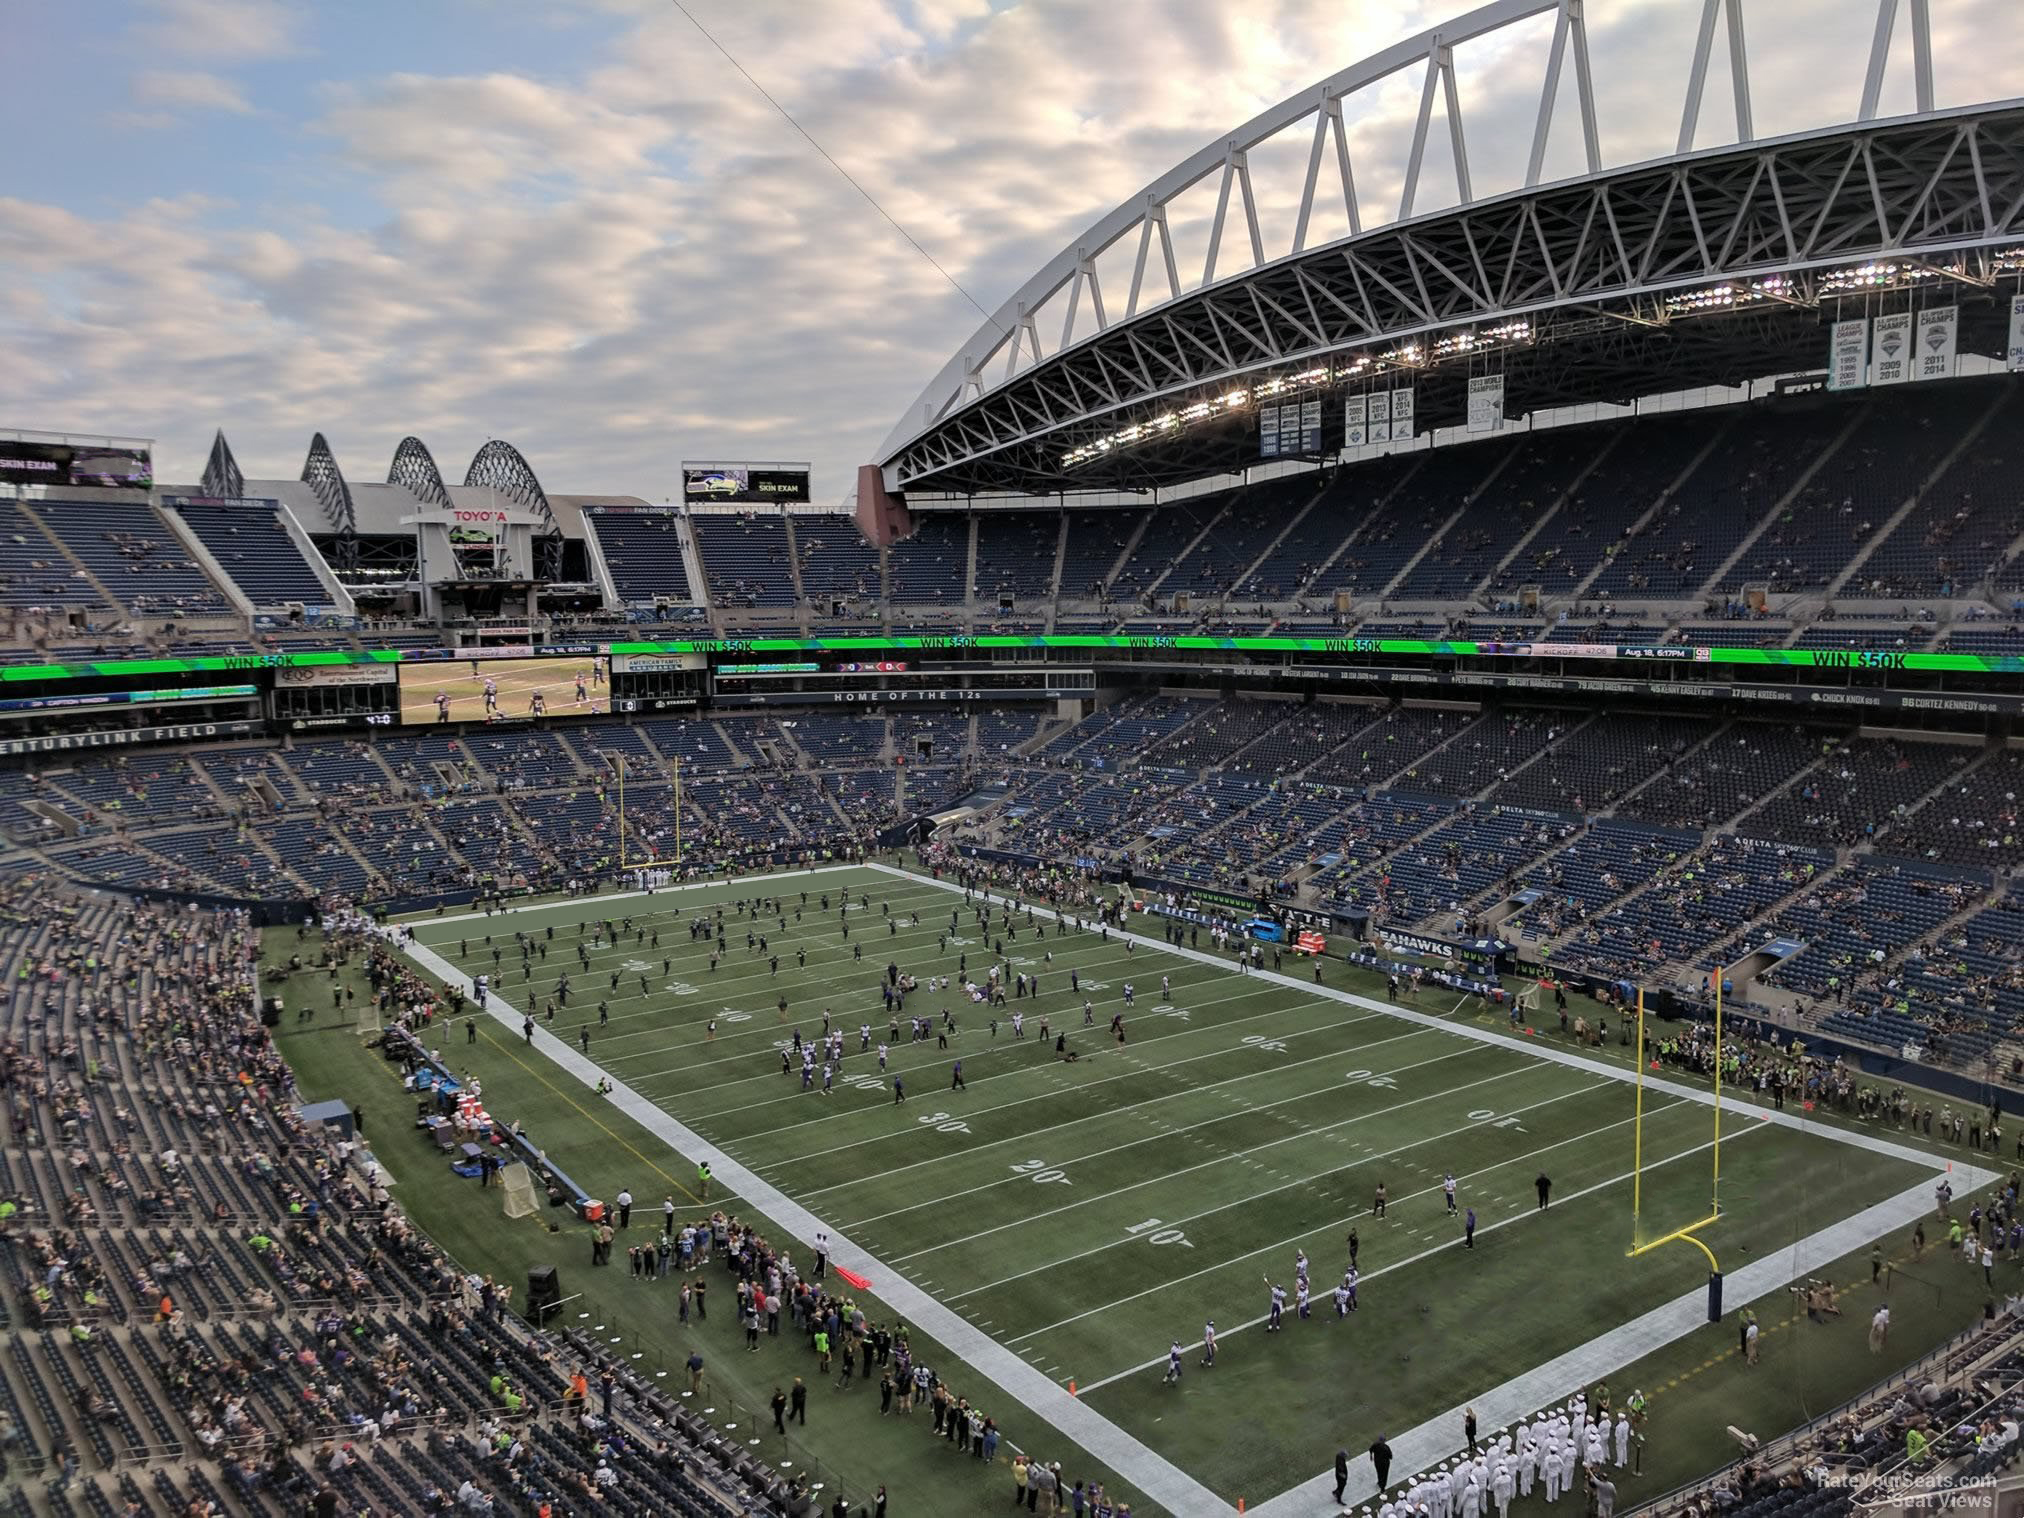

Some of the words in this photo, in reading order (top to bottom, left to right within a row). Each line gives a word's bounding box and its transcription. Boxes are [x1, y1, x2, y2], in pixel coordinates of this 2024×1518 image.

[1920, 314, 1954, 325] CHAMPS
[1838, 323, 1862, 331] LEAGUE
[1877, 321, 1909, 332] CHAMPS
[1837, 329, 1863, 338] CHAMPS
[1880, 361, 1901, 370] 2009
[1924, 355, 1944, 365] 2011
[1880, 370, 1900, 380] 2010
[1924, 365, 1945, 375] 2014
[1372, 404, 1386, 413] 2013
[27, 461, 57, 470] EXAM
[692, 641, 717, 651] WIN
[722, 641, 752, 651] $50K
[920, 638, 944, 648] WIN
[949, 638, 978, 648] $50K
[1130, 637, 1149, 648] WIN
[1152, 637, 1177, 648] $50K
[1325, 640, 1348, 651] WIN
[1353, 640, 1382, 652] $50K
[1625, 648, 1641, 657] Aug.
[1643, 649, 1655, 657] 18,
[1657, 649, 1685, 657] 6:17PM
[224, 658, 254, 669] WIN
[259, 655, 294, 668] $50K
[1813, 652, 1850, 668] WIN
[1857, 653, 1906, 670] $50K
[1391, 673, 1399, 681] 22
[834, 692, 879, 702] HOME
[889, 692, 908, 701] OF
[919, 691, 948, 701] THE
[959, 691, 981, 700] 12s
[1732, 688, 1740, 697] 17
[1741, 689, 1756, 698] DAVE
[1822, 693, 1844, 702] CHUCK
[1846, 695, 1864, 704] KNOX
[1915, 698, 1943, 709] CORTEZ
[1944, 699, 1978, 711] KENNEDY
[155, 726, 217, 739] FIELD
[1501, 806, 1523, 814] DELTA
[1742, 838, 1771, 848] DELTA
[1268, 904, 1331, 928] SATTE
[841, 1073, 884, 1089] 40
[1346, 1070, 1397, 1087] 20
[918, 1112, 967, 1132] 30
[1467, 1109, 1521, 1127] 10
[1009, 1159, 1065, 1183] 20
[1124, 1218, 1185, 1244] 10
